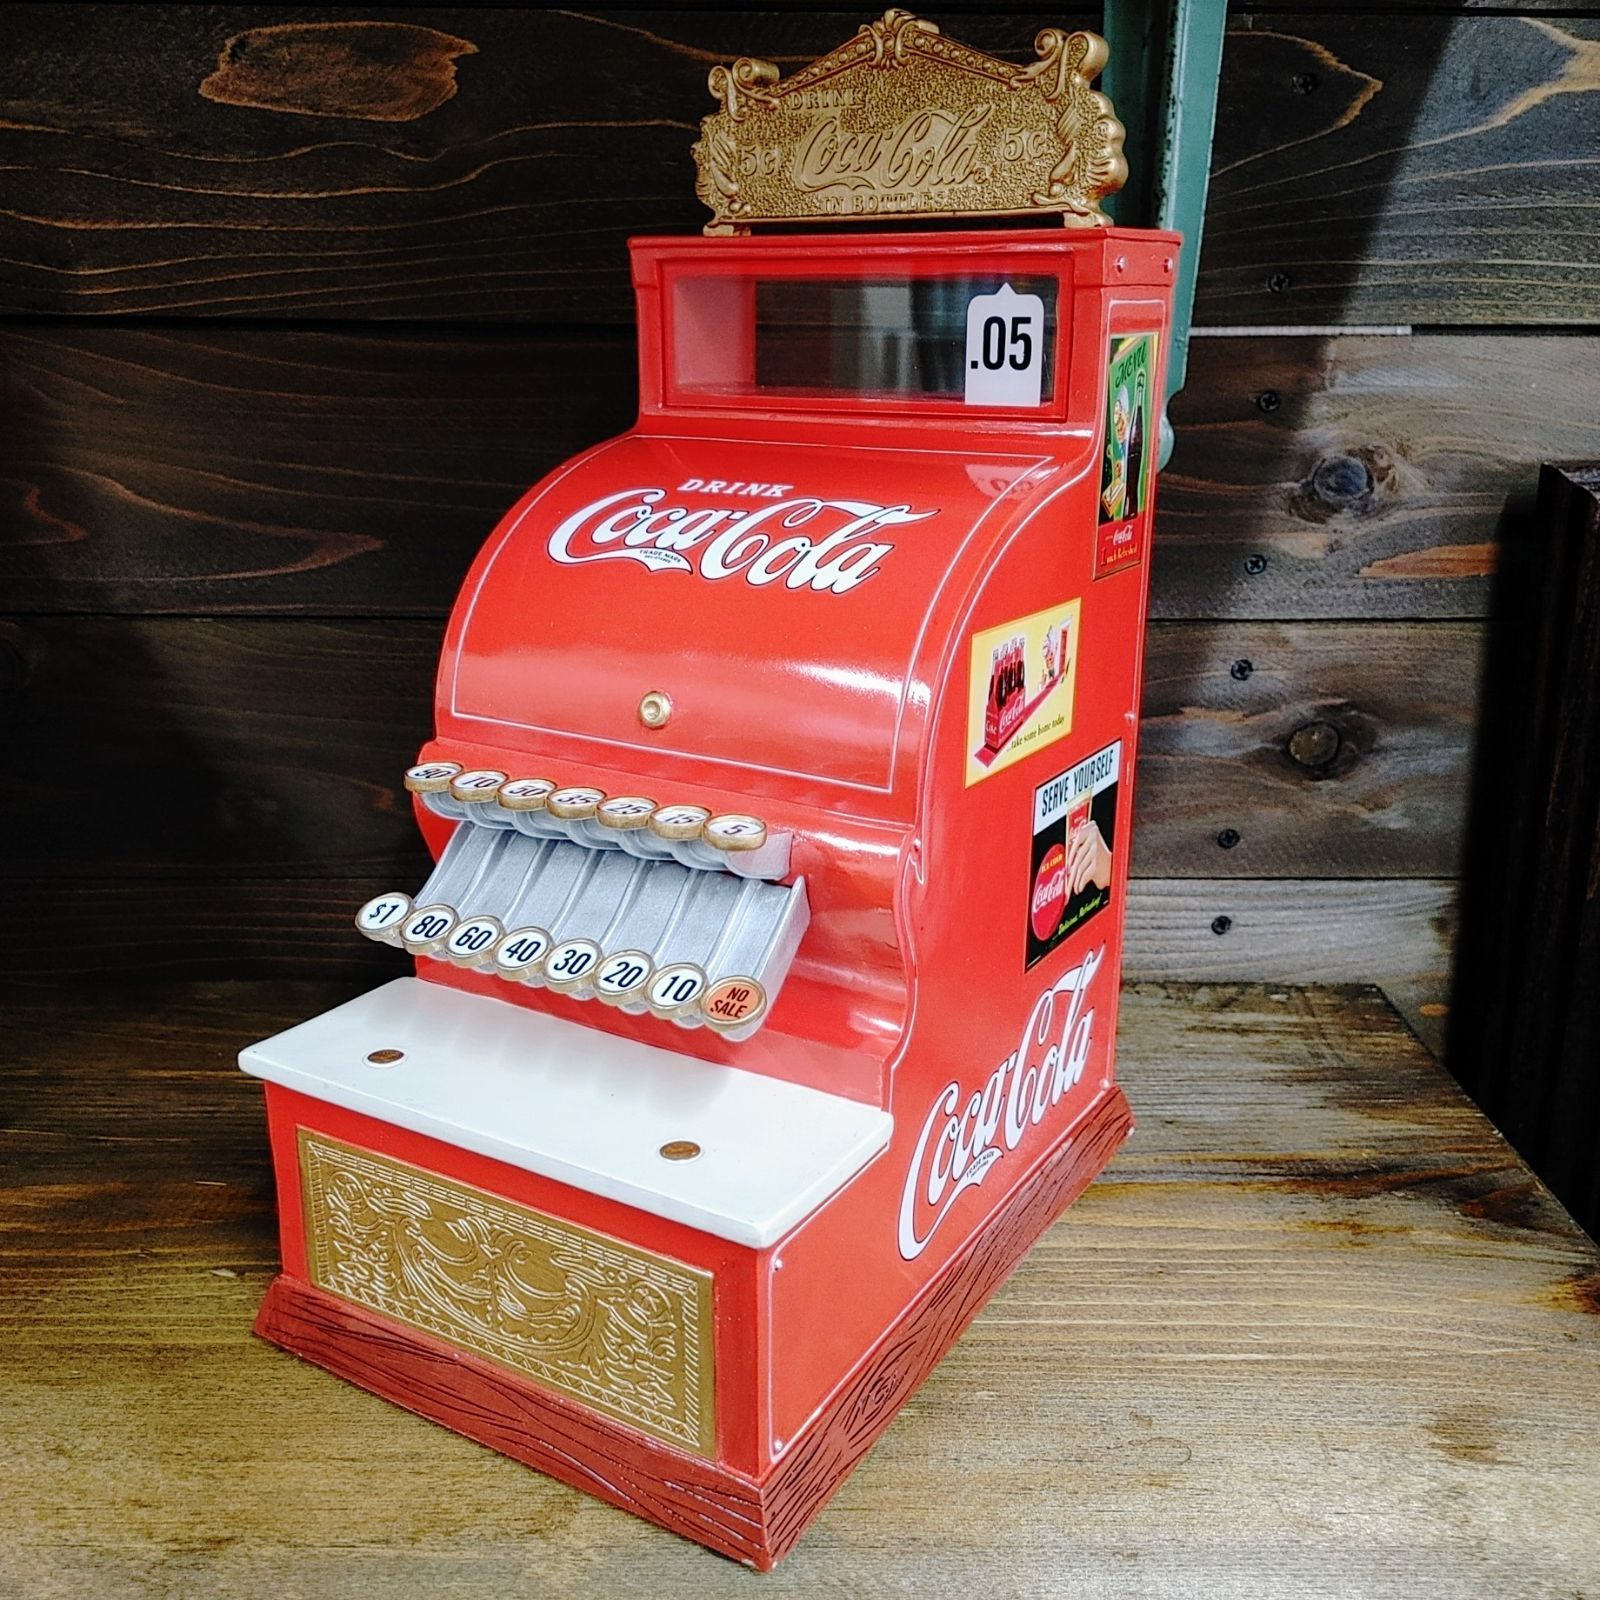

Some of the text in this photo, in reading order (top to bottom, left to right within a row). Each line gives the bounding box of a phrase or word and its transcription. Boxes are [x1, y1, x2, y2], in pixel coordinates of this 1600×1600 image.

[790, 88, 866, 111] DRINK
[824, 192, 946, 213] IN BOTTLES
[970, 316, 1032, 371] .05
[1115, 341, 1146, 388] MENU
[678, 479, 795, 497] DRINK
[1023, 731, 1037, 743] some
[1037, 723, 1052, 736] home
[1041, 748, 1114, 817] SERVE YOURSELF
[607, 803, 649, 815] 25
[664, 813, 700, 825] 15
[722, 823, 749, 836] 5
[369, 904, 398, 924] $1
[411, 914, 448, 939] 80
[455, 927, 493, 951] 60
[504, 937, 542, 963] 40
[553, 949, 592, 976] 30
[602, 961, 644, 988] 20
[662, 974, 698, 1003] 10
[726, 985, 749, 1003] NO
[709, 999, 748, 1019] SALE
